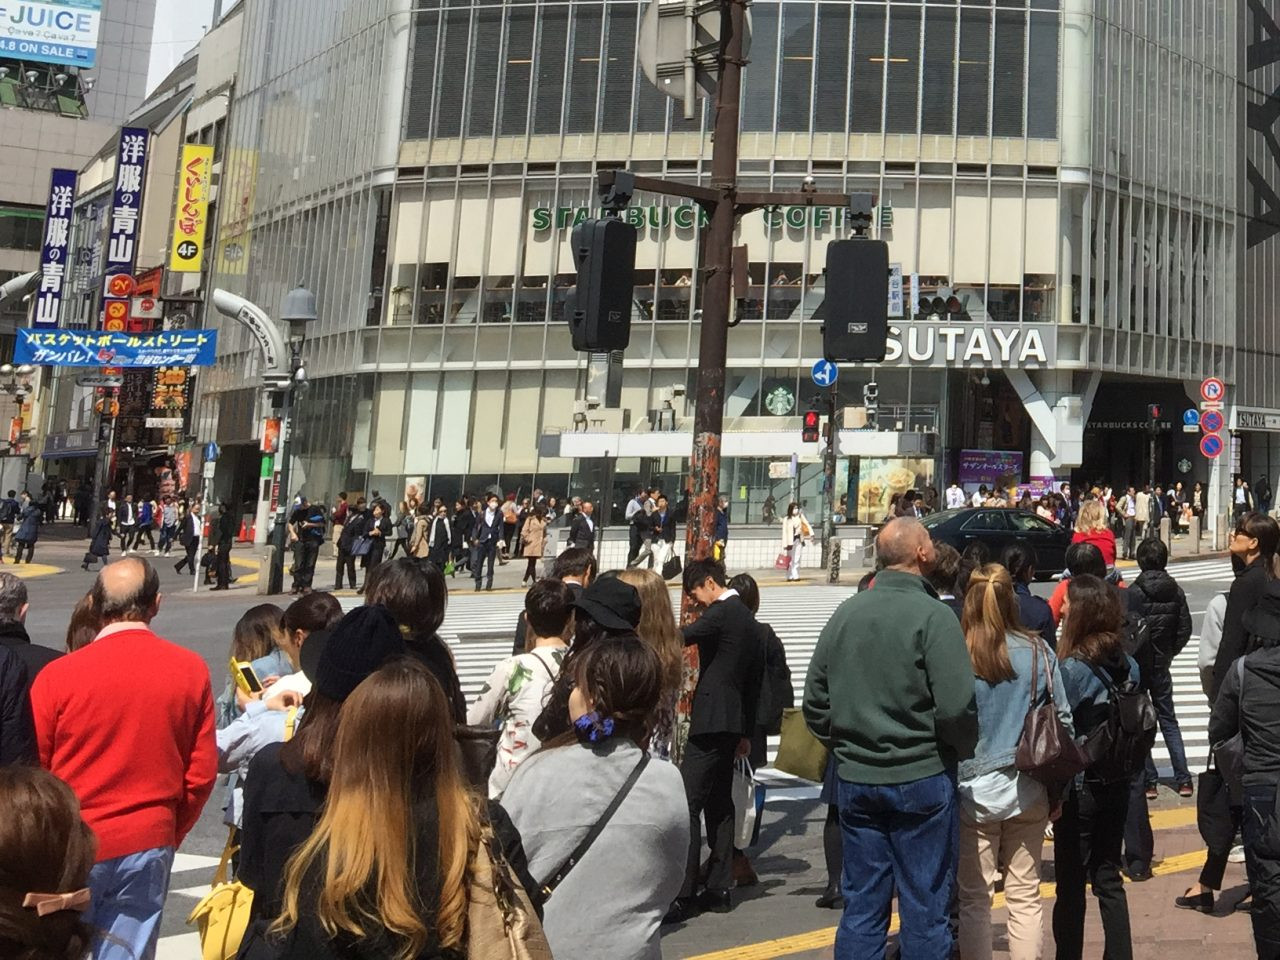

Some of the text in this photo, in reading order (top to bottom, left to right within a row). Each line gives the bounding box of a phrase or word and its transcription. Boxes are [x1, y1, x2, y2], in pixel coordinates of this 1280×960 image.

[19, 42, 38, 54] ON
[41, 44, 74, 58] SALE
[107, 135, 145, 263] 洋服の青山
[763, 205, 894, 230] COFFE
[36, 185, 72, 323] 洋服の青山
[177, 244, 197, 256] 4F
[26, 333, 208, 348] バスケットボールストリート
[884, 325, 1047, 362] SUTAYA
